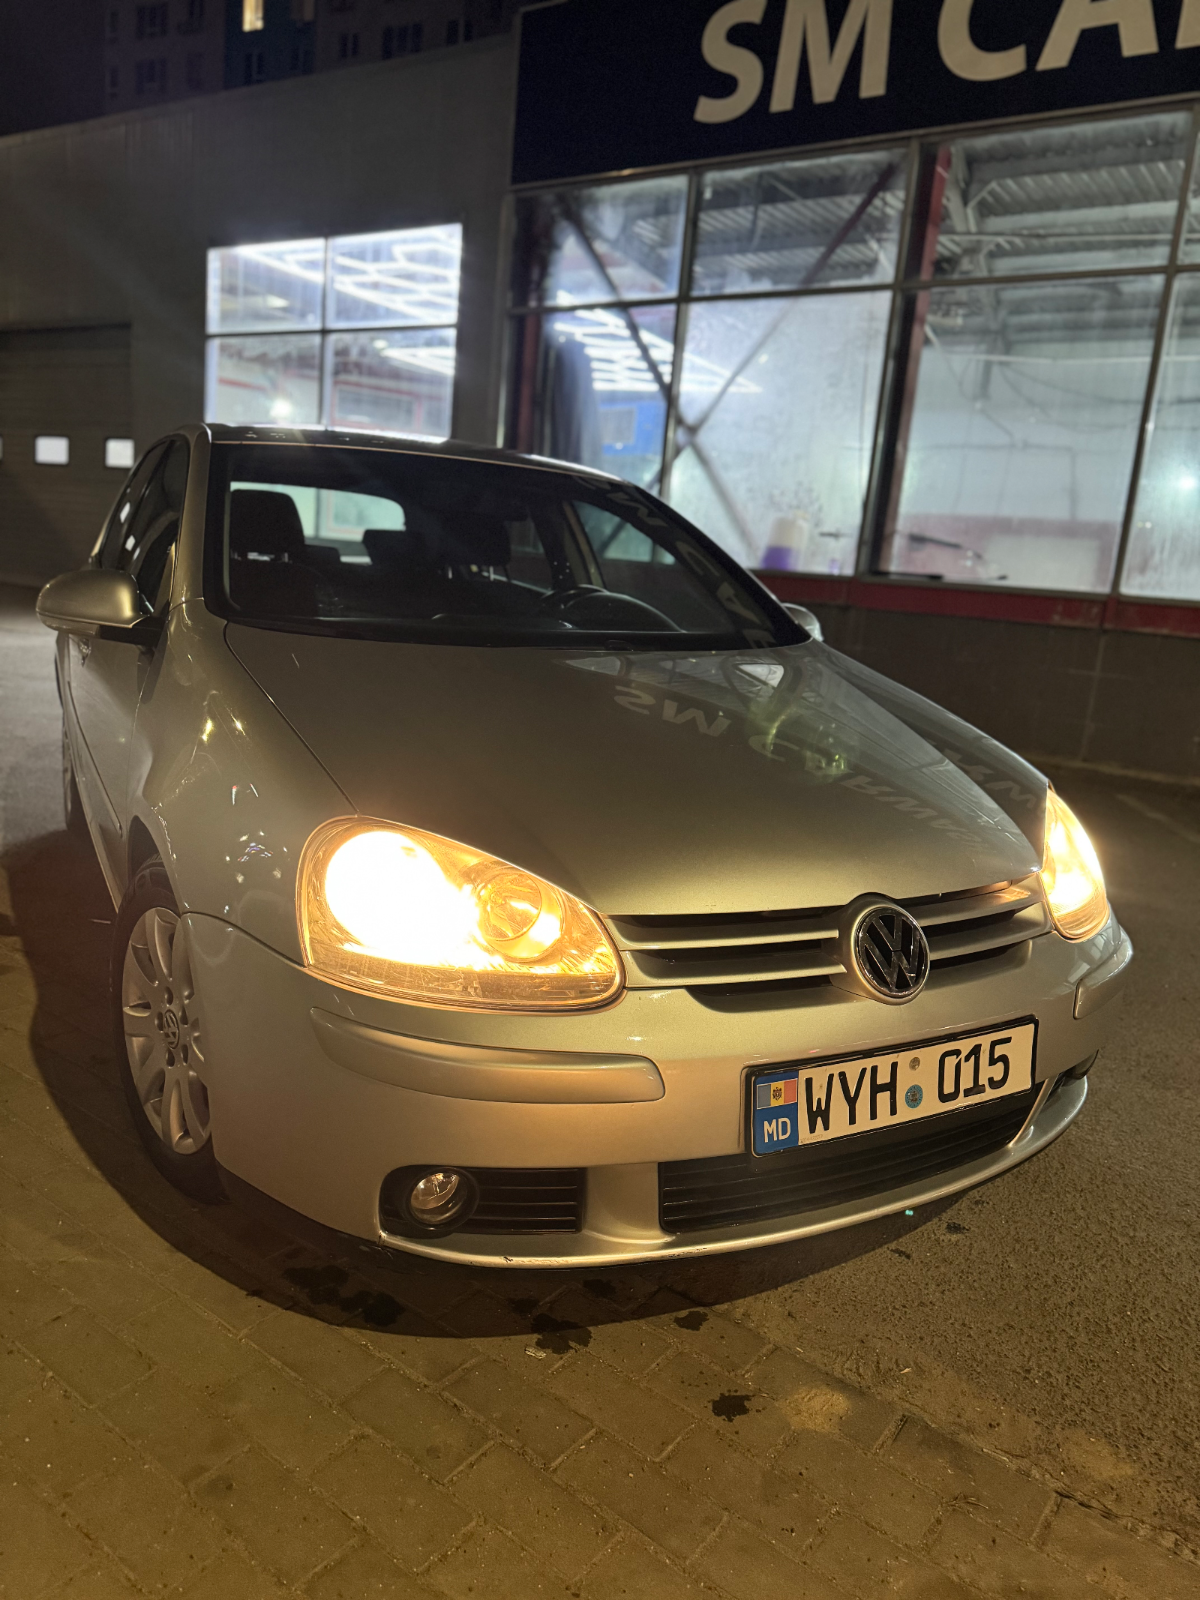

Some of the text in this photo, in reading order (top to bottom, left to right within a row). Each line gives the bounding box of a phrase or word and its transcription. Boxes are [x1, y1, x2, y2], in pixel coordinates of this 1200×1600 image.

[695, 0, 1200, 123] SM CA
[763, 1117, 792, 1144] MD
[805, 1037, 1013, 1133] WYH 015
